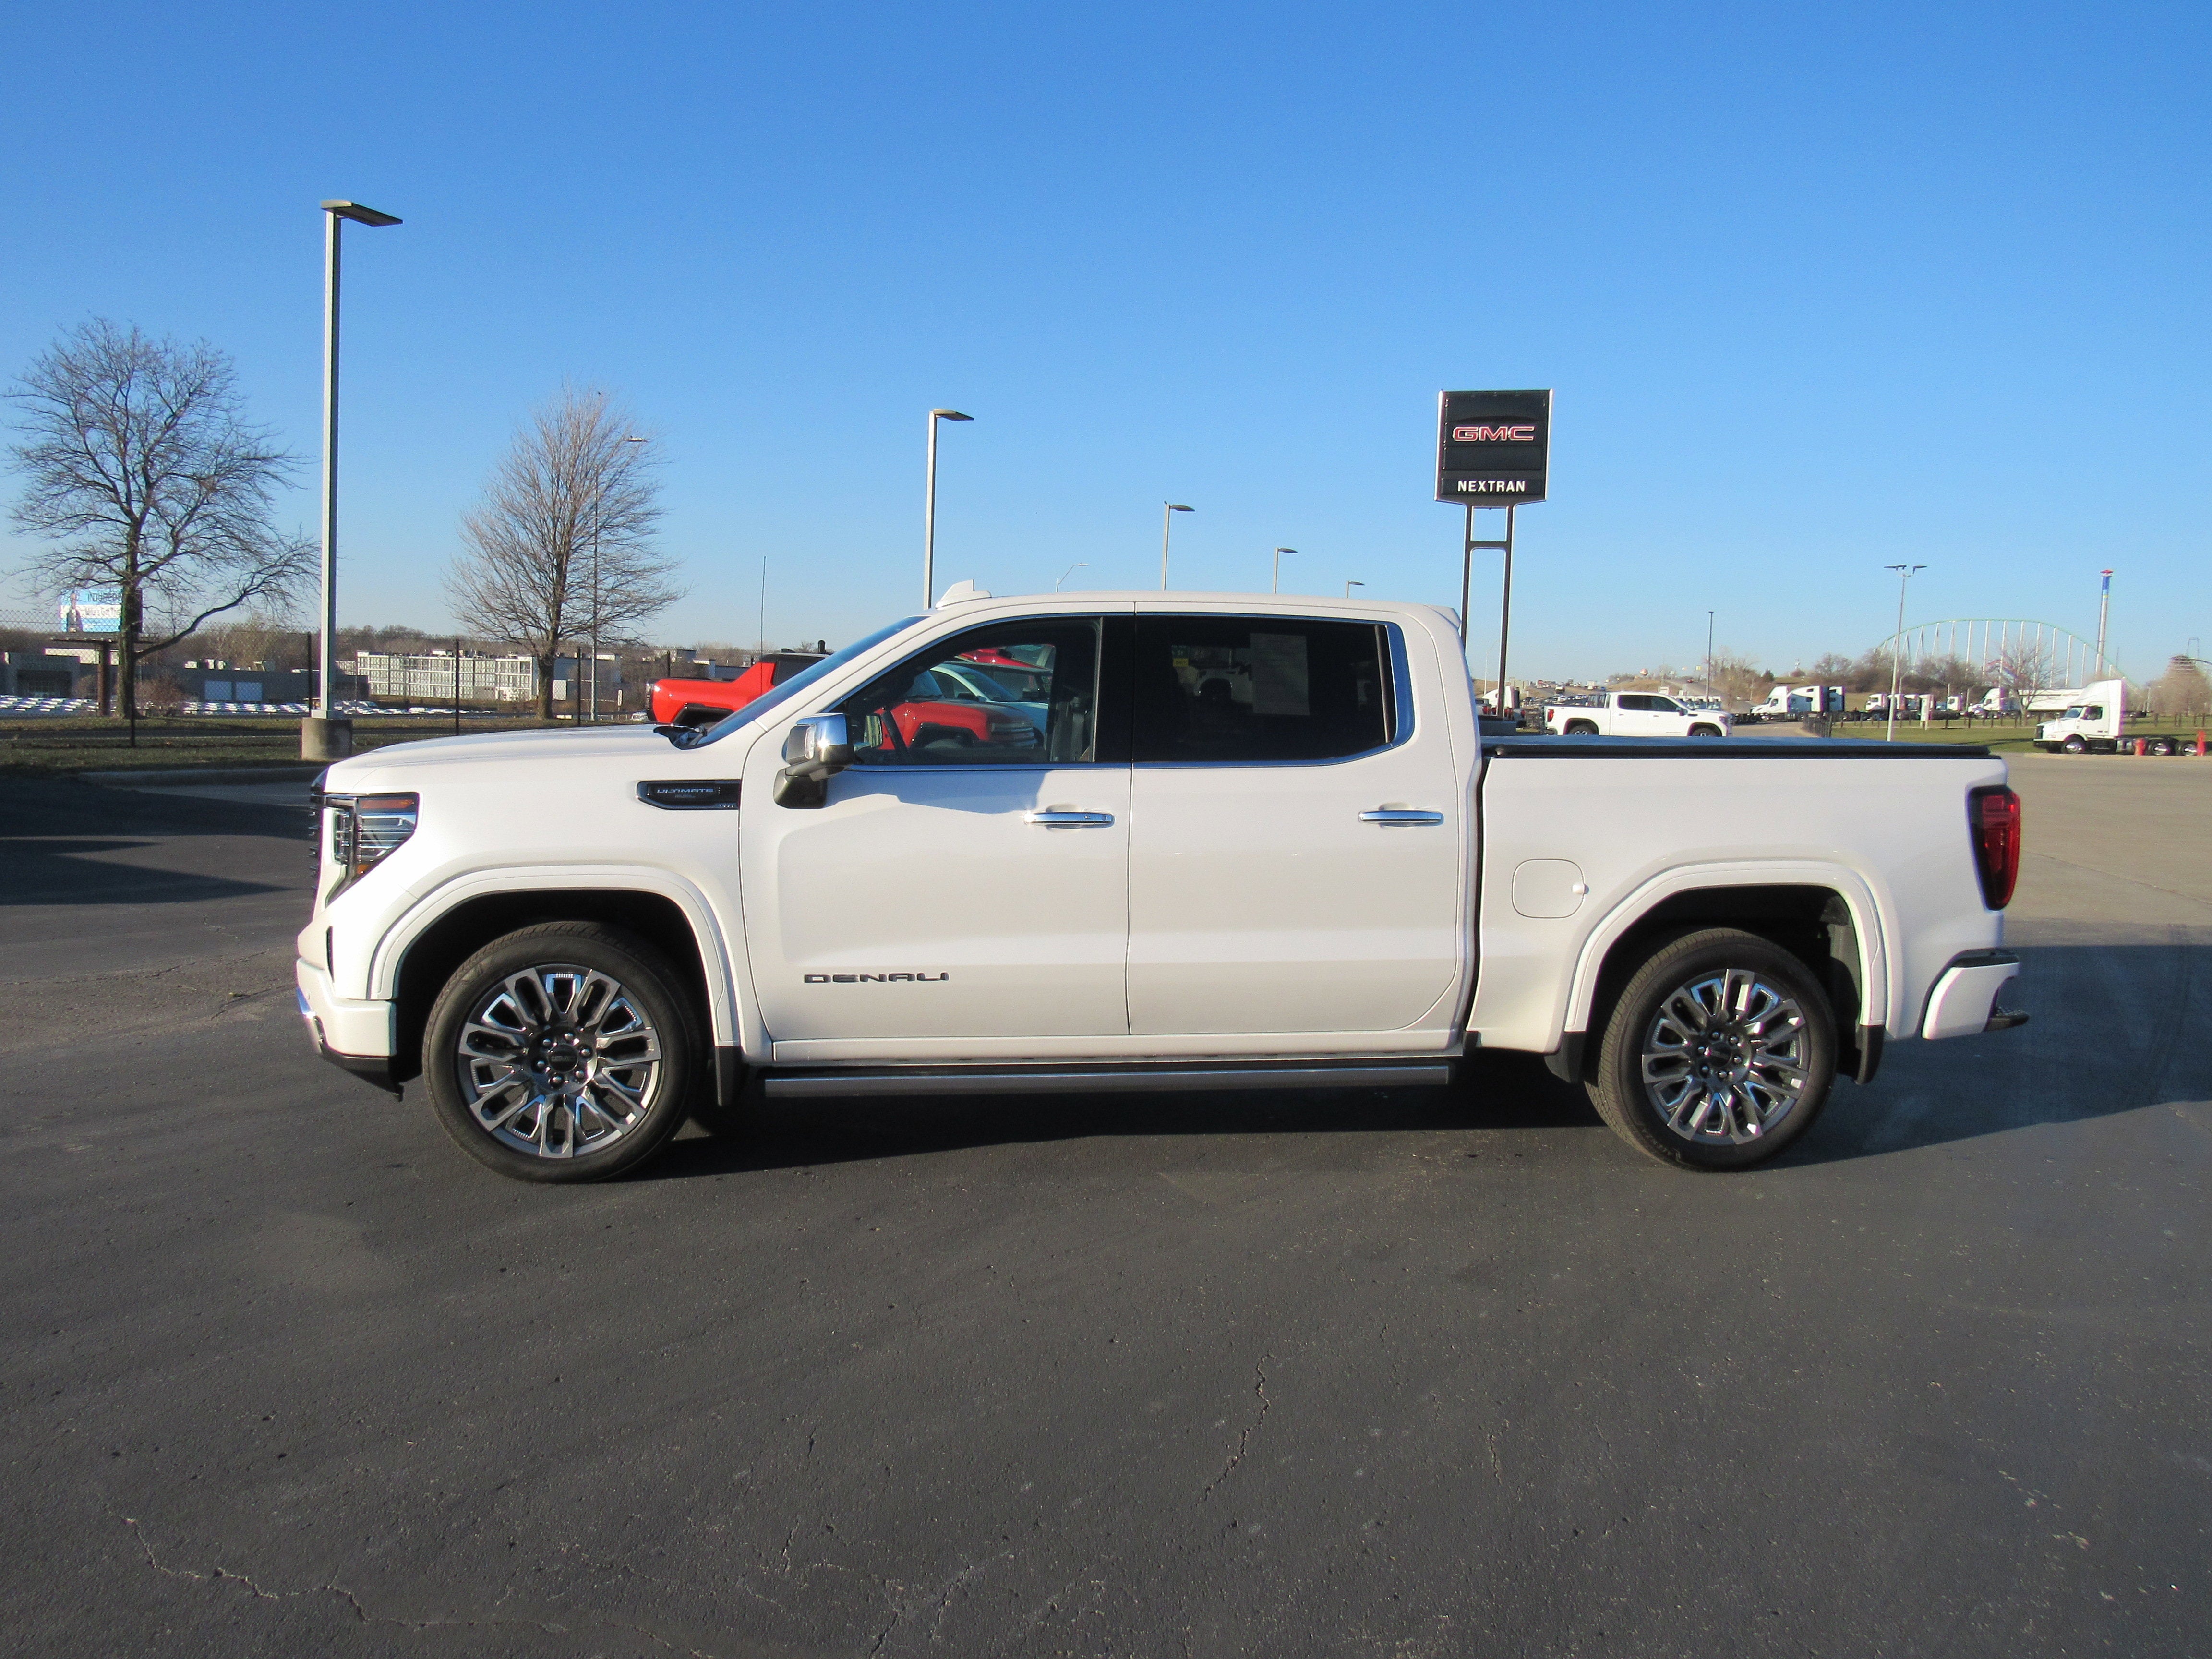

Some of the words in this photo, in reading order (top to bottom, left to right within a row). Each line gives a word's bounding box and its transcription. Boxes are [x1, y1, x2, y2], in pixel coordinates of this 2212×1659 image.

[1453, 426, 1535, 441] GMC
[1457, 480, 1526, 492] NEXTRAN
[804, 972, 950, 983] DENALI
